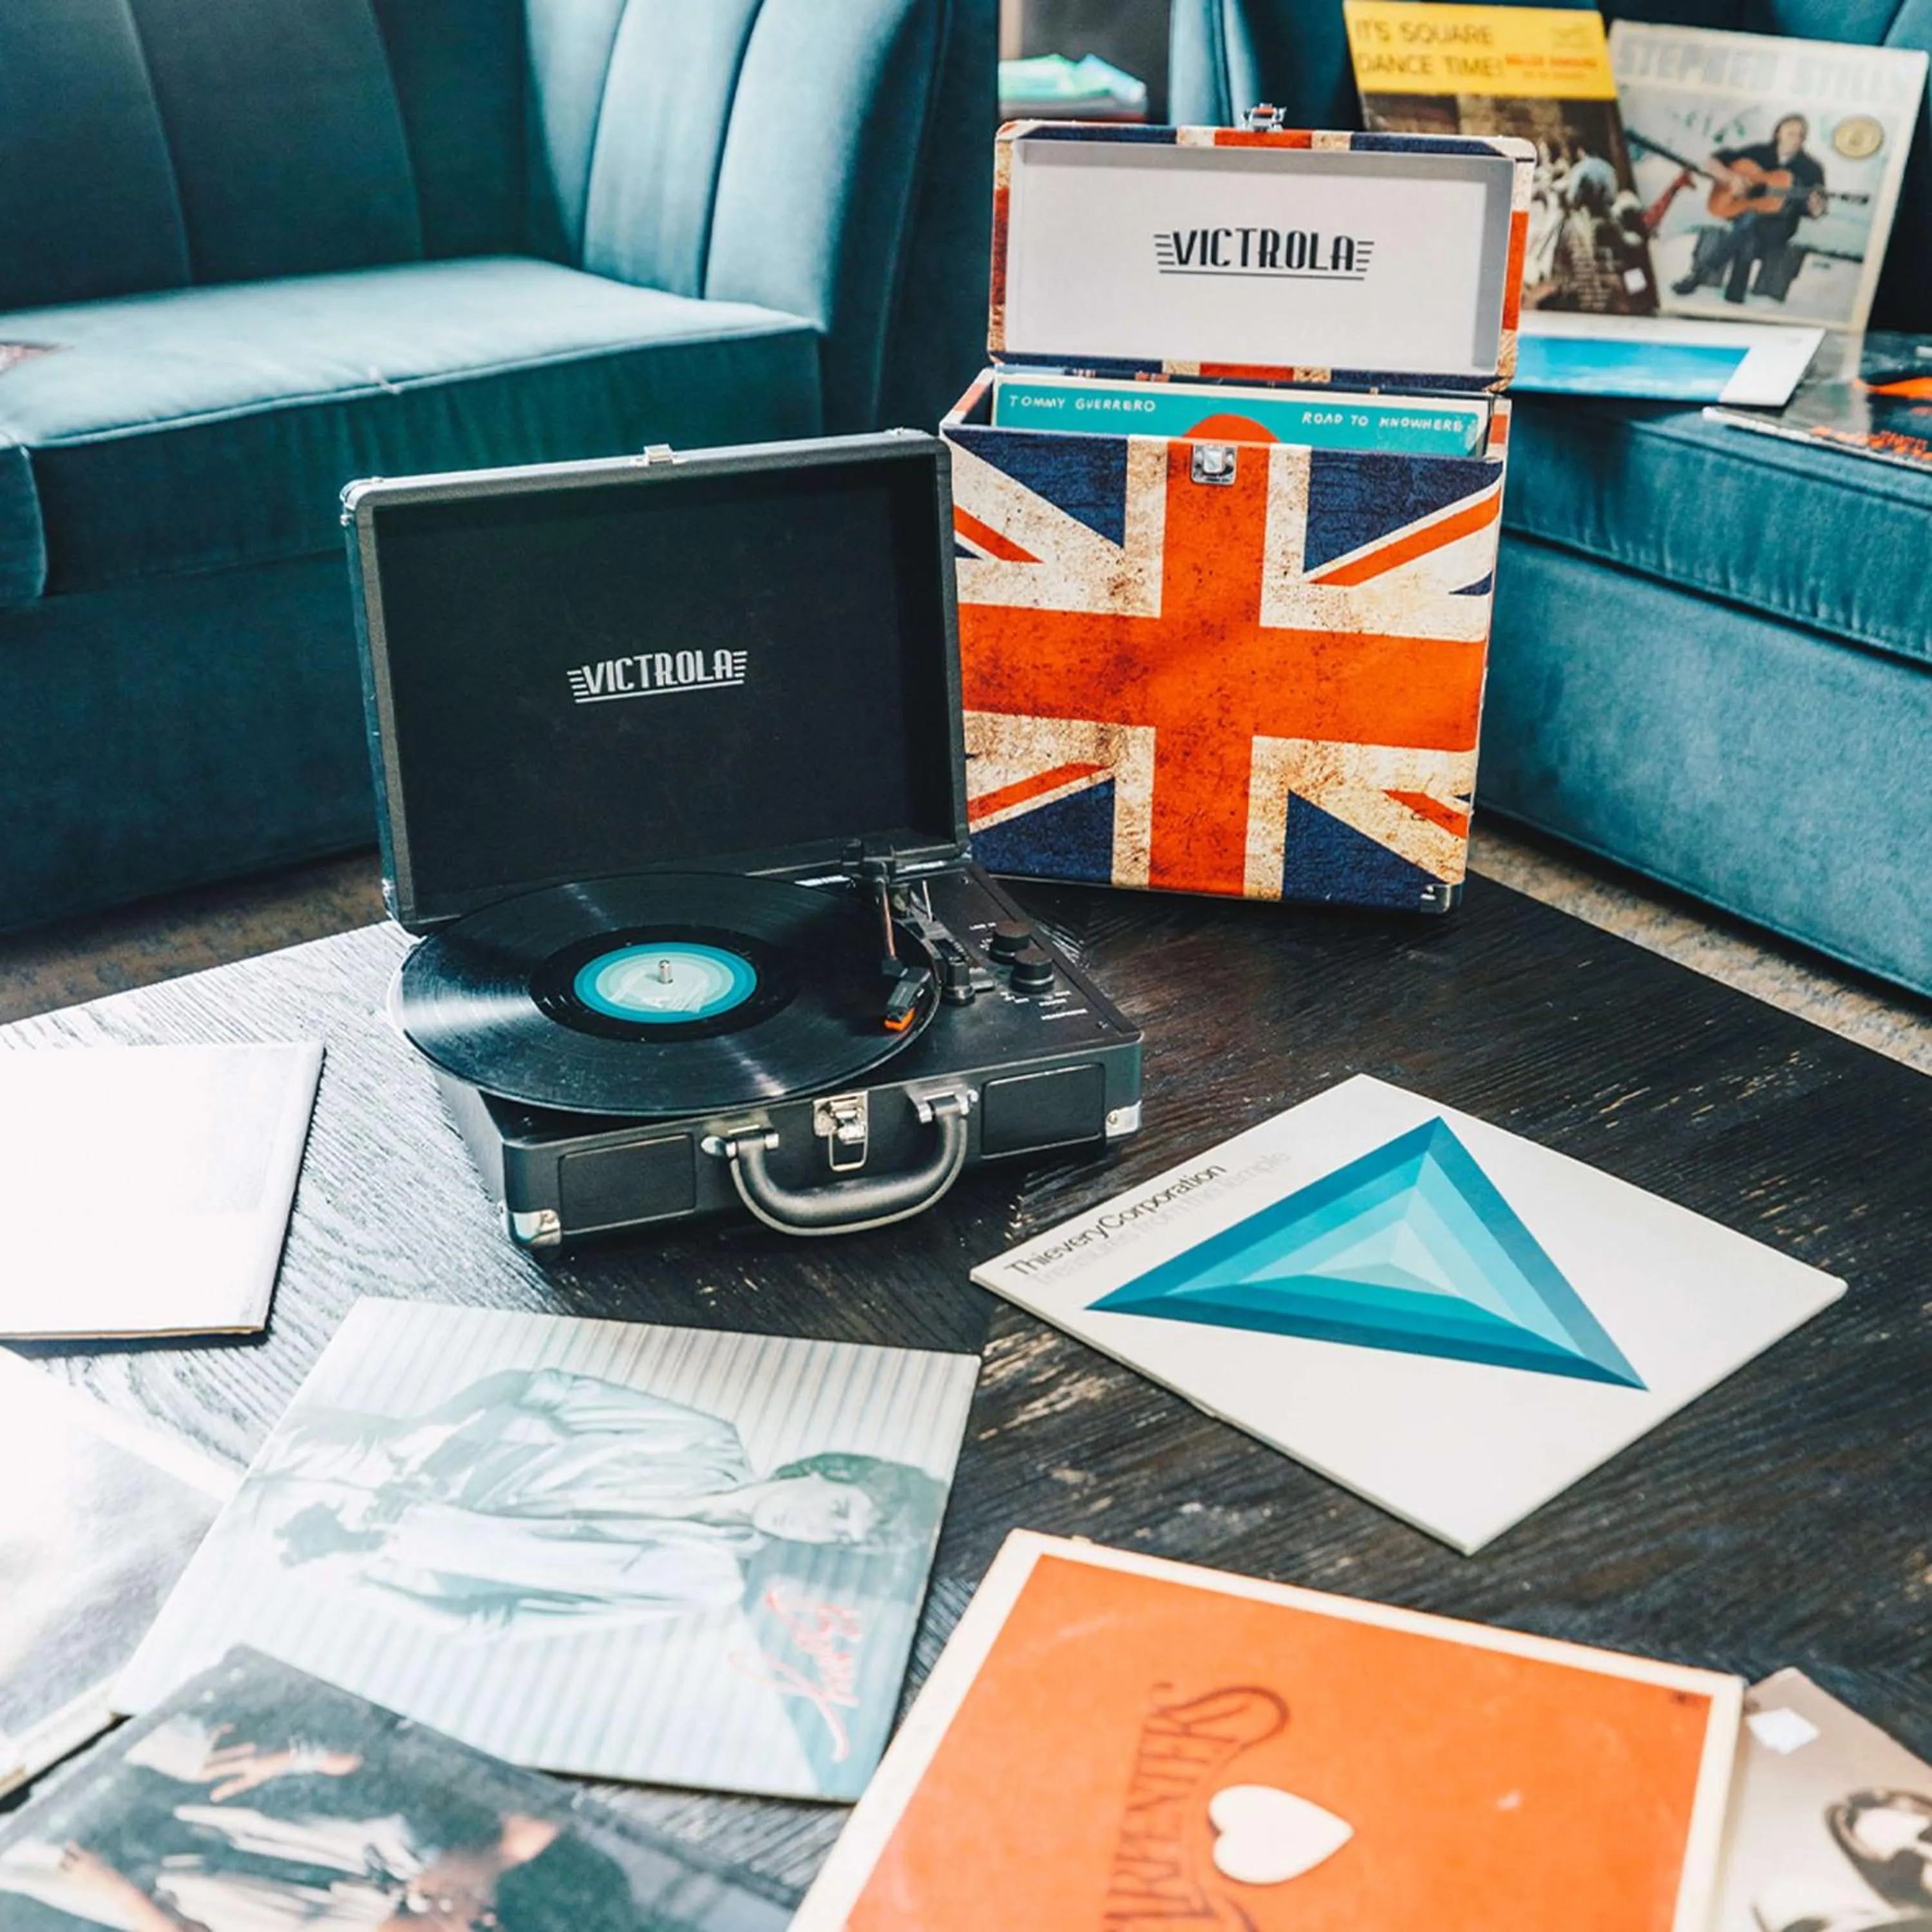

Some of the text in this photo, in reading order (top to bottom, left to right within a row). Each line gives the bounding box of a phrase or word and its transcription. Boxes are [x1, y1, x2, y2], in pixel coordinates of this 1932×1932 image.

[1356, 16, 1493, 45] IT'S SQUARE
[1357, 52, 1434, 75] DANCE
[1173, 227, 1355, 272] VICTROLA
[1009, 395, 1156, 412] TOMMY GUERRERO
[1302, 411, 1463, 433] ROAD TO KNOWHERE
[581, 649, 734, 695] VICTROLA
[1102, 1681, 1290, 1932] RPENTERS
